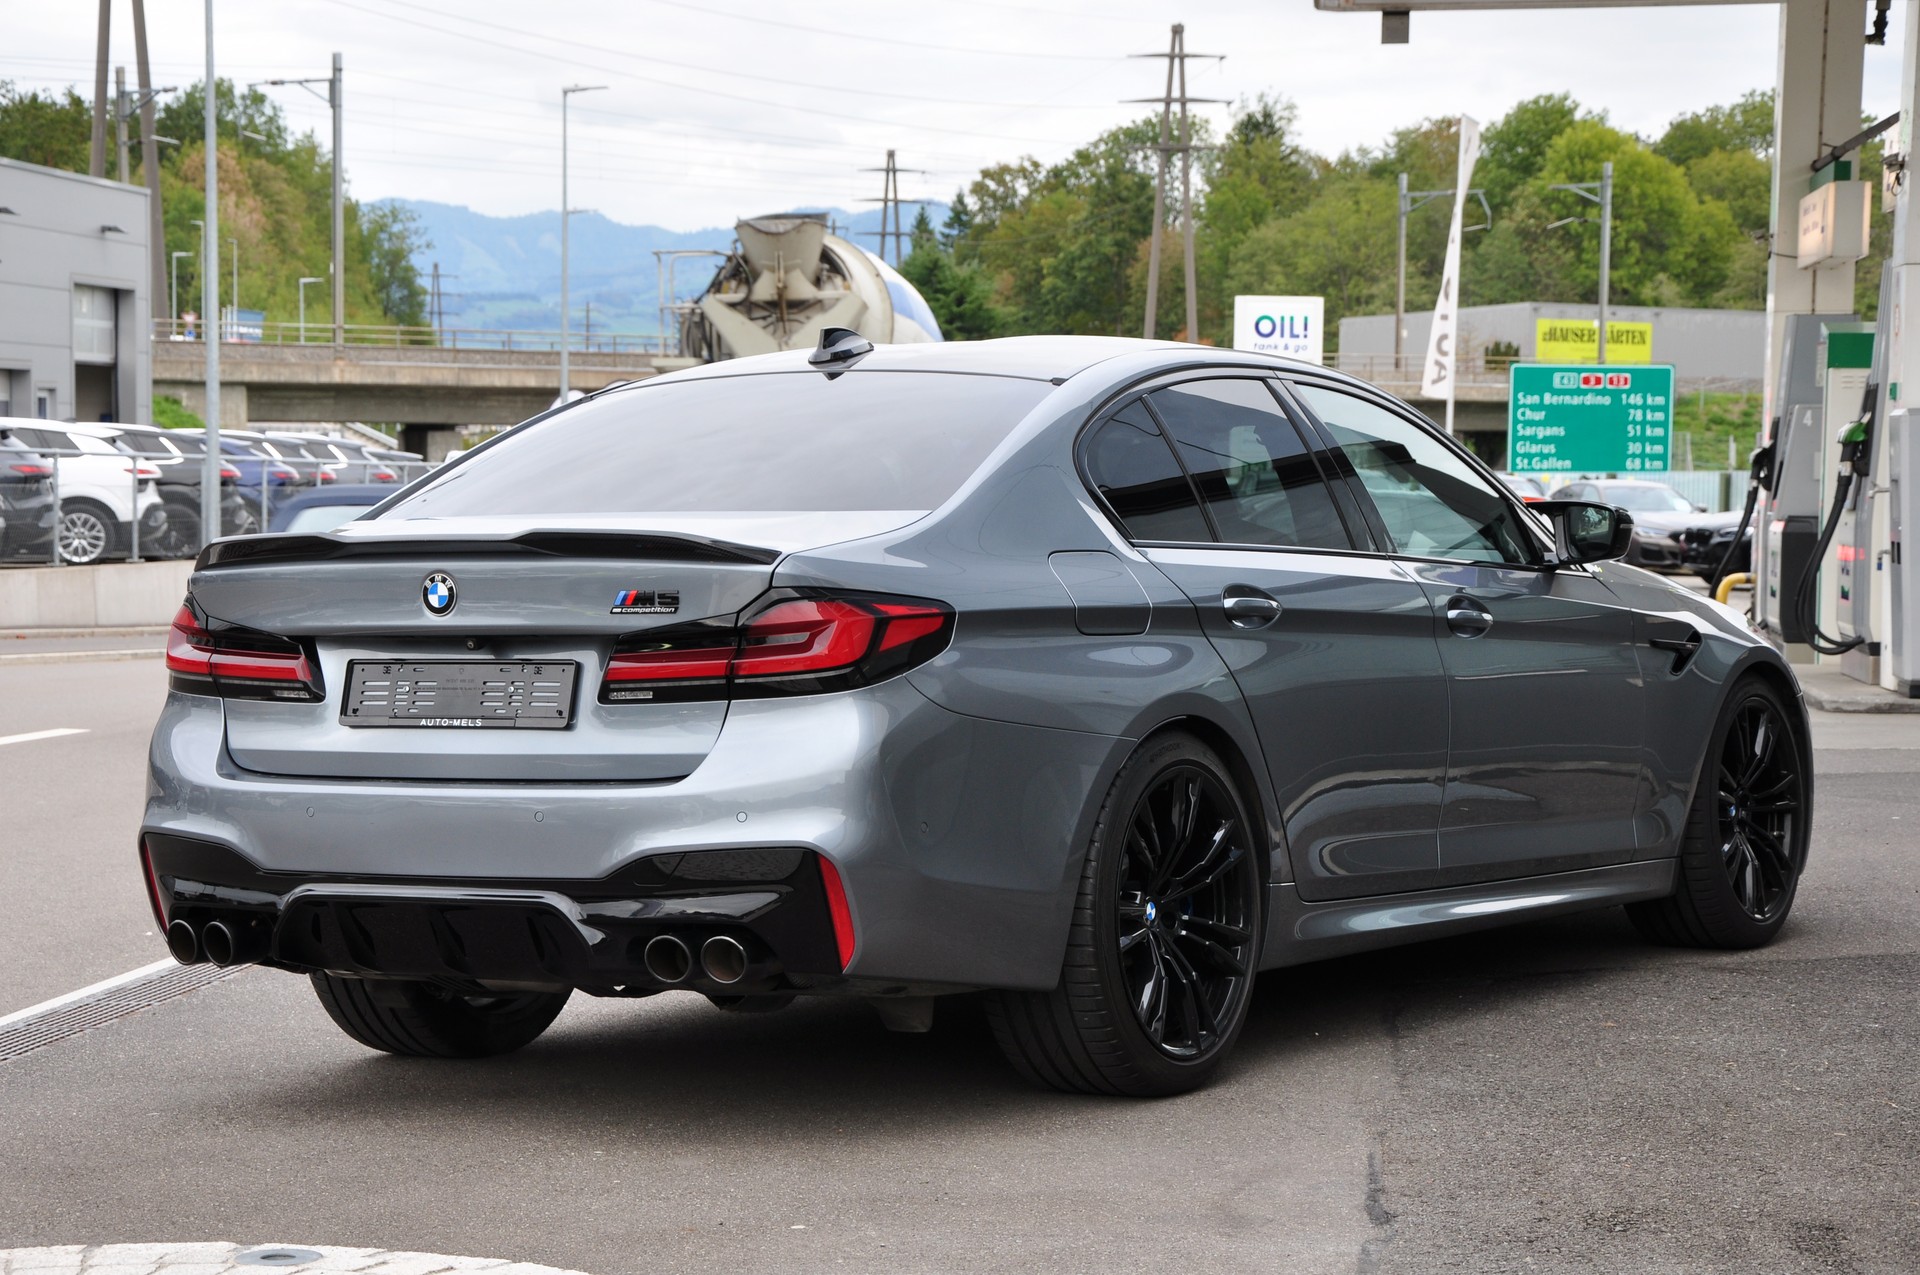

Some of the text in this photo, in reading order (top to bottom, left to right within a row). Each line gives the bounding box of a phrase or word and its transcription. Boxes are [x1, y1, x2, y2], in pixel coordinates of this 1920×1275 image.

[1254, 314, 1309, 339] OIL!
[1606, 325, 1646, 344] ÄRTEN
[1253, 343, 1308, 353] tank & go
[1517, 393, 1665, 405] San Bernardino 146 km
[1517, 408, 1665, 421] Chur 78 km
[1803, 409, 1813, 426] 4
[1516, 424, 1664, 439] Sargans 51 km
[1516, 441, 1664, 454] Glarus 30 km
[1626, 457, 1642, 470] 68
[1645, 457, 1664, 470] km
[424, 574, 453, 588] BMW
[629, 589, 680, 607] M5
[621, 606, 675, 614] competition
[419, 718, 483, 727] AUTO-MELS
